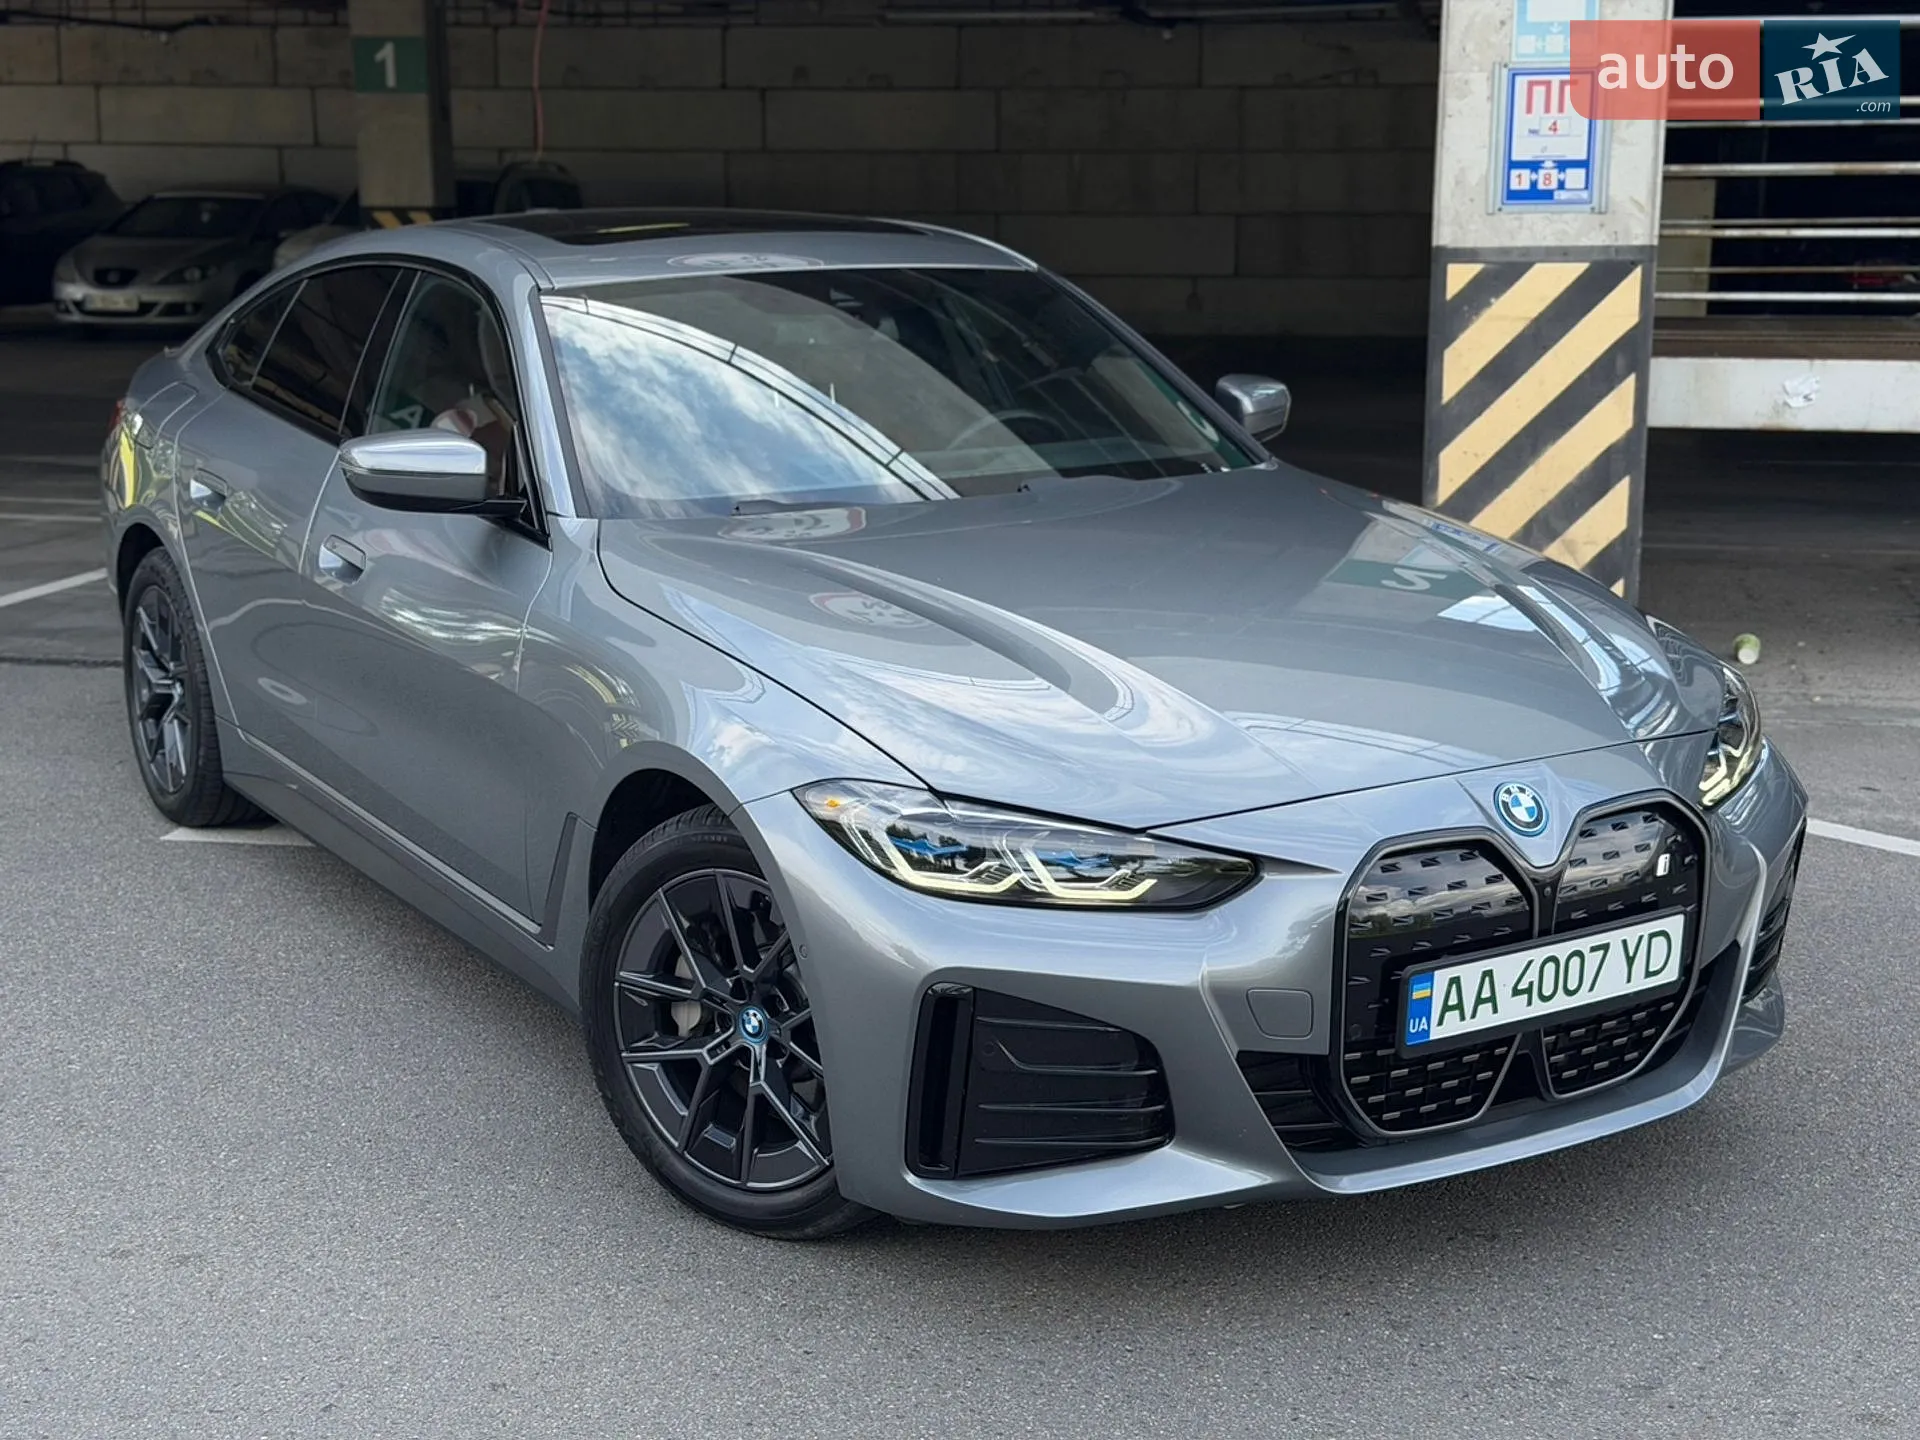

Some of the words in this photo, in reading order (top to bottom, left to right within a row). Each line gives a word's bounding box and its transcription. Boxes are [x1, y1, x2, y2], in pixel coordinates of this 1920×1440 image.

[373, 40, 398, 89] 1
[1547, 119, 1559, 135] 4
[1515, 172, 1523, 187] 1
[1542, 172, 1553, 187] 8
[1436, 969, 1499, 1028] AA
[1511, 942, 1612, 1009] 4007
[1620, 928, 1673, 984] YD
[1409, 1016, 1428, 1034] UA
